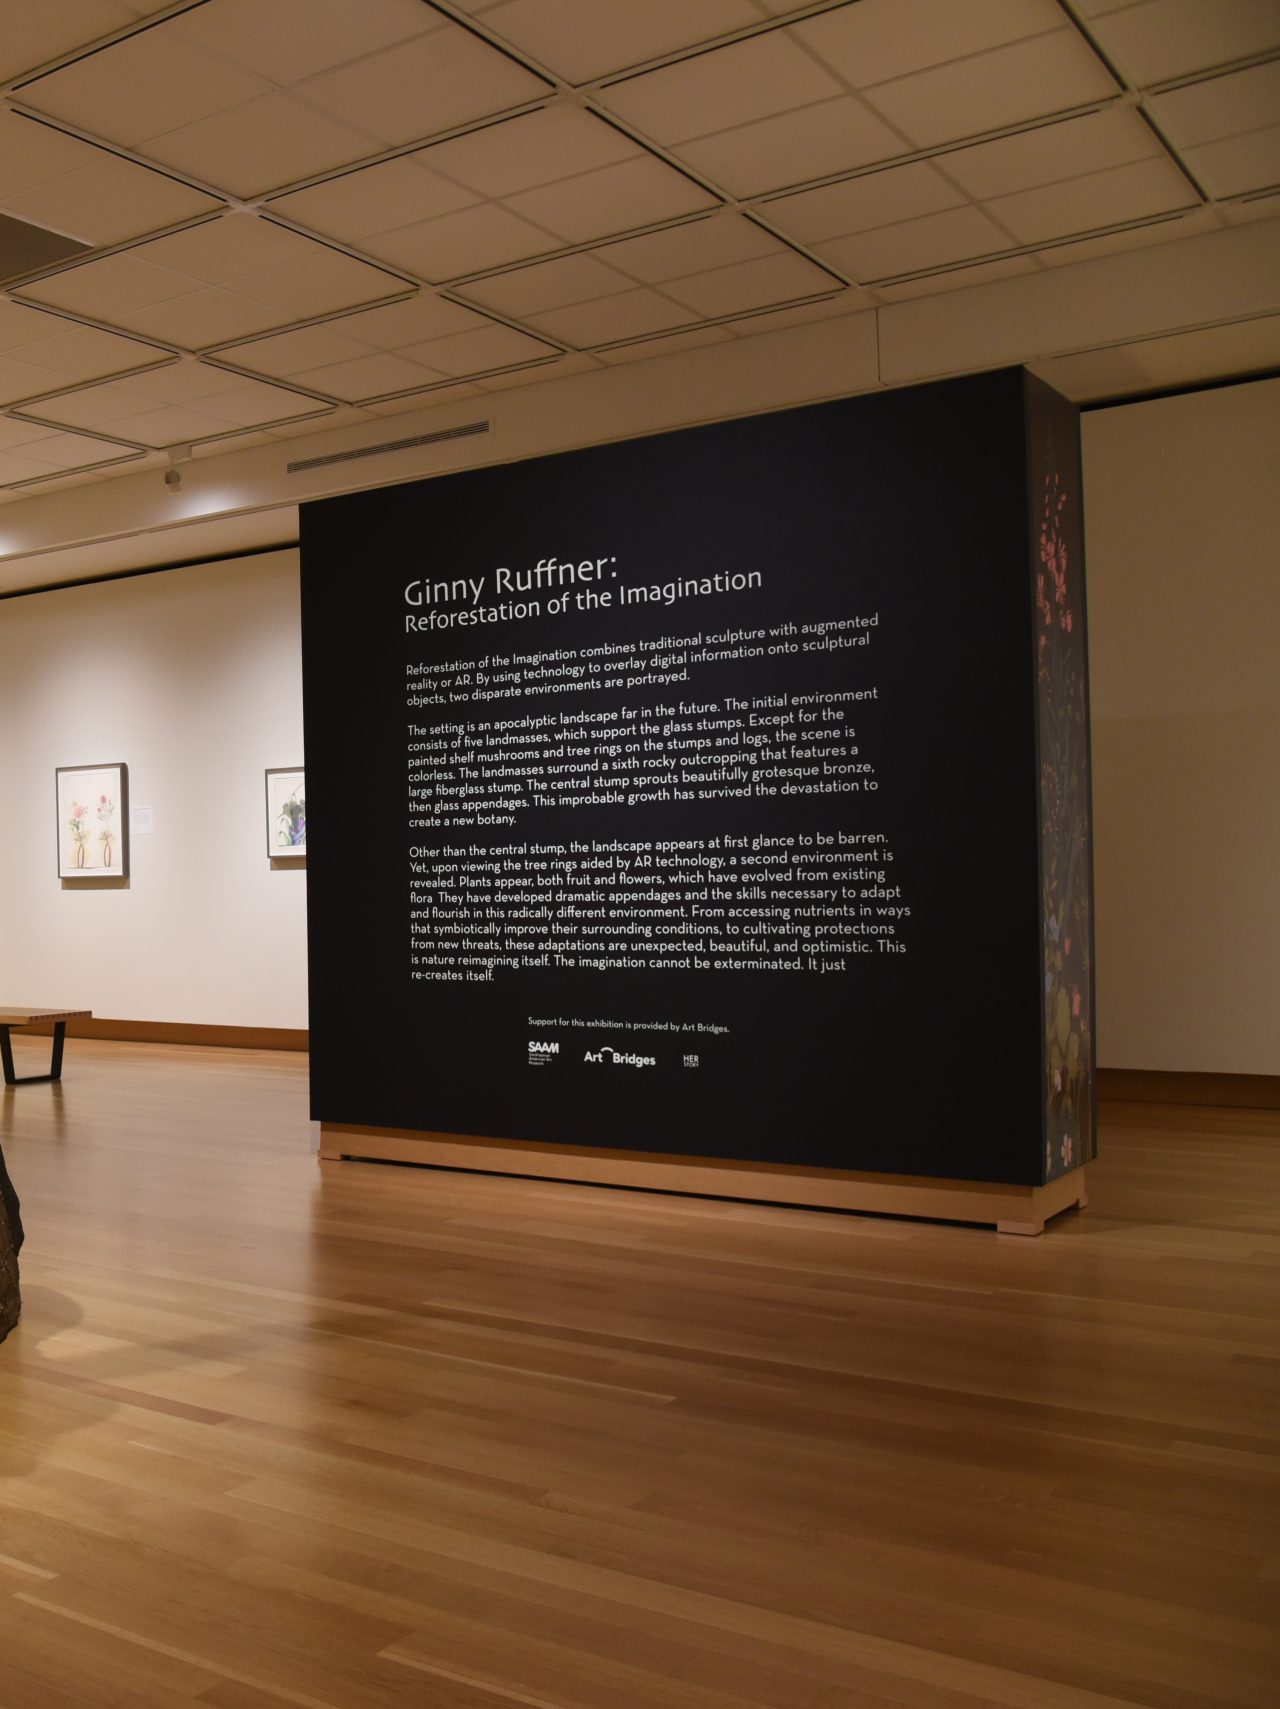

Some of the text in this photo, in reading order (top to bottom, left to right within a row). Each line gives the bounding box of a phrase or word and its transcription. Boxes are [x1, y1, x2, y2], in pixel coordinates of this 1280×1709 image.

[404, 557, 617, 606] Ginny Ruffner:
[405, 571, 762, 633] Reforestation of the Imagination
[406, 612, 878, 676] Reforestation of the Imagination combines traditional sculpture with augmented
[406, 631, 869, 691] reality or AR. By using technology to overlay digital information onto sculptural
[406, 668, 690, 708] objects, two disparate environments are portrayed.
[407, 687, 878, 736] The setting is an apocalyptic landscape far in the future. The initial environment
[408, 725, 855, 770] painted shelf mushrooms and tree rings on the stumps and logs, the scene is
[408, 761, 875, 800] large fiberglass stump. The central stump sprouts beautifully grotesque bronze,
[409, 813, 517, 828] create a new botany.
[409, 831, 888, 858] Other than the central stump, the landscape appears at first glance to be barren.
[410, 867, 886, 890] revealed. Plants appear, both fruit and flowers, which have evolved from existing
[410, 904, 911, 921] and flourish in this radically different environment. From accessing nutrients in ways
[411, 937, 906, 955] from new threats, these adaptations are unexpected, beautiful, and optimistic. This
[411, 953, 846, 974] is nature reimagining itself. The imagination cannot be exterminated. It just
[411, 969, 494, 981] re-creates itself.
[528, 1016, 730, 1035] Support for this exhibition is provided by Art Bridges.
[528, 1041, 560, 1054] SAAM
[683, 1054, 699, 1063] HER
[584, 1051, 656, 1068] Art Bridges
